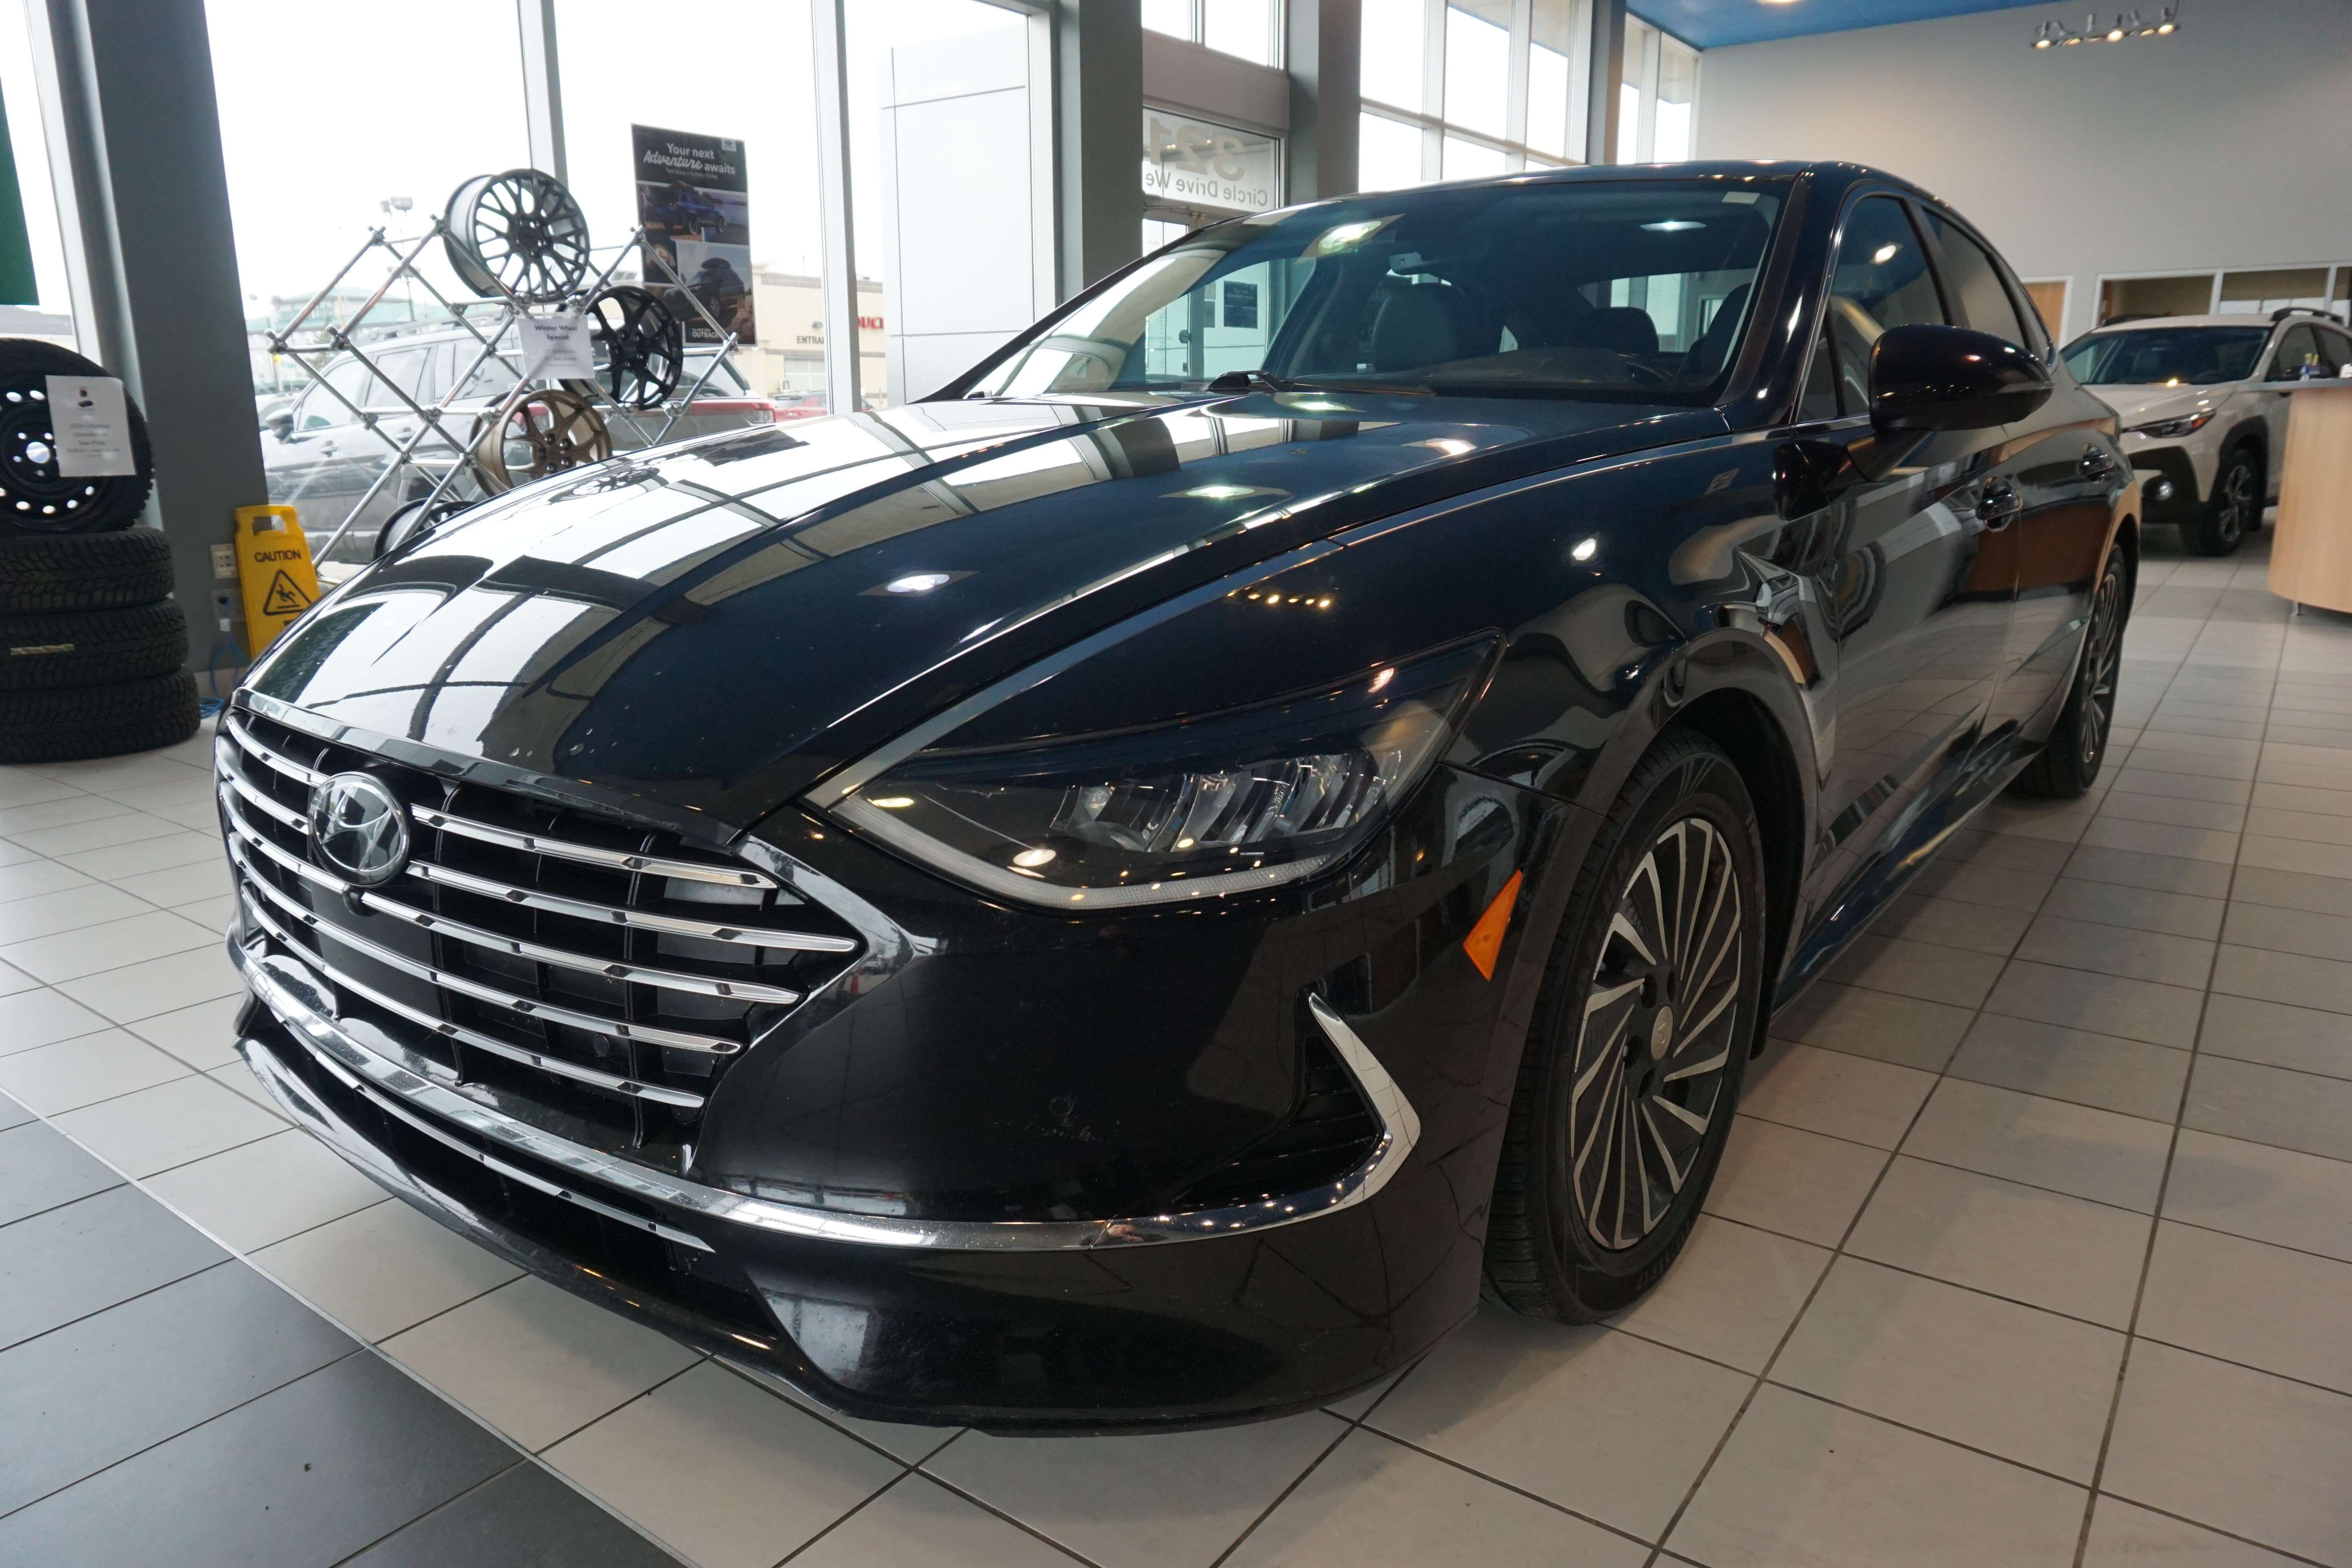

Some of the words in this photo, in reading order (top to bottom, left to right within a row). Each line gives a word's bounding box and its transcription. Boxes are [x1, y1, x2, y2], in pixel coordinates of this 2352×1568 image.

[666, 143, 690, 156] Your
[692, 148, 714, 159] next
[643, 149, 704, 169] Adventure
[704, 163, 735, 174] awaits
[254, 549, 301, 563] CAUTION
